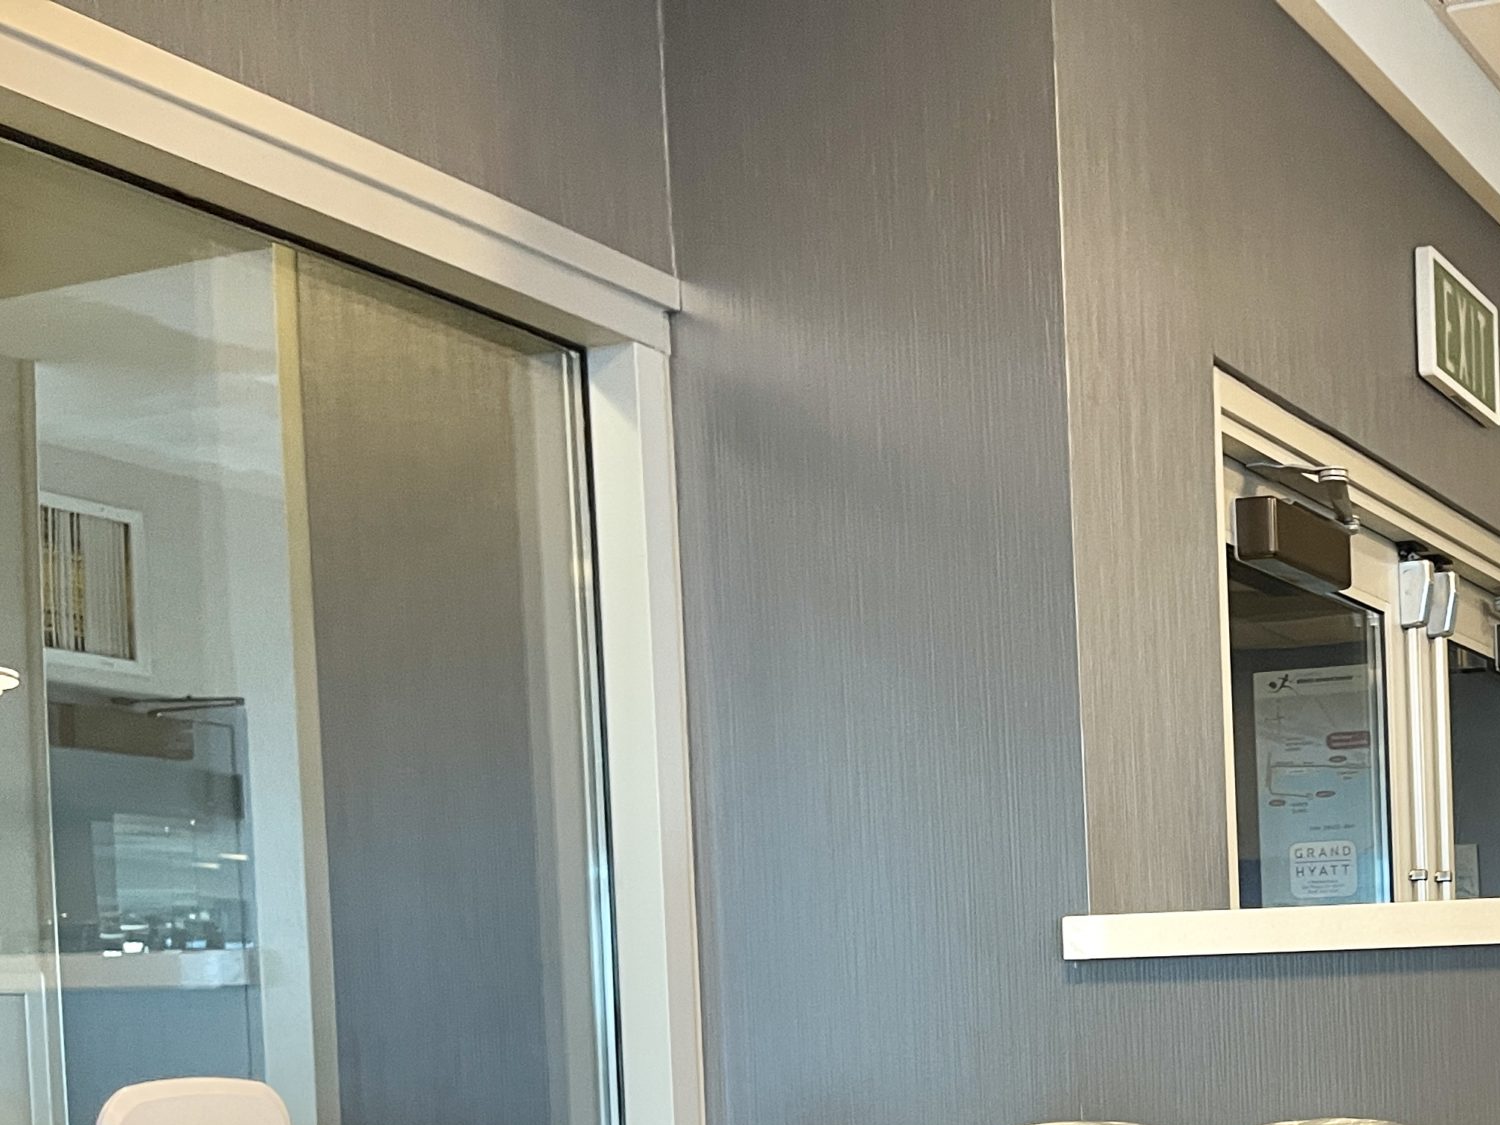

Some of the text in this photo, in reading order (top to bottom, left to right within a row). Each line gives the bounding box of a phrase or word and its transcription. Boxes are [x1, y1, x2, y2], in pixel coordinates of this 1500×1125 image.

[1442, 278, 1486, 400] EXIT
[1294, 845, 1352, 859] GRAND
[1295, 863, 1351, 877] HYATT
